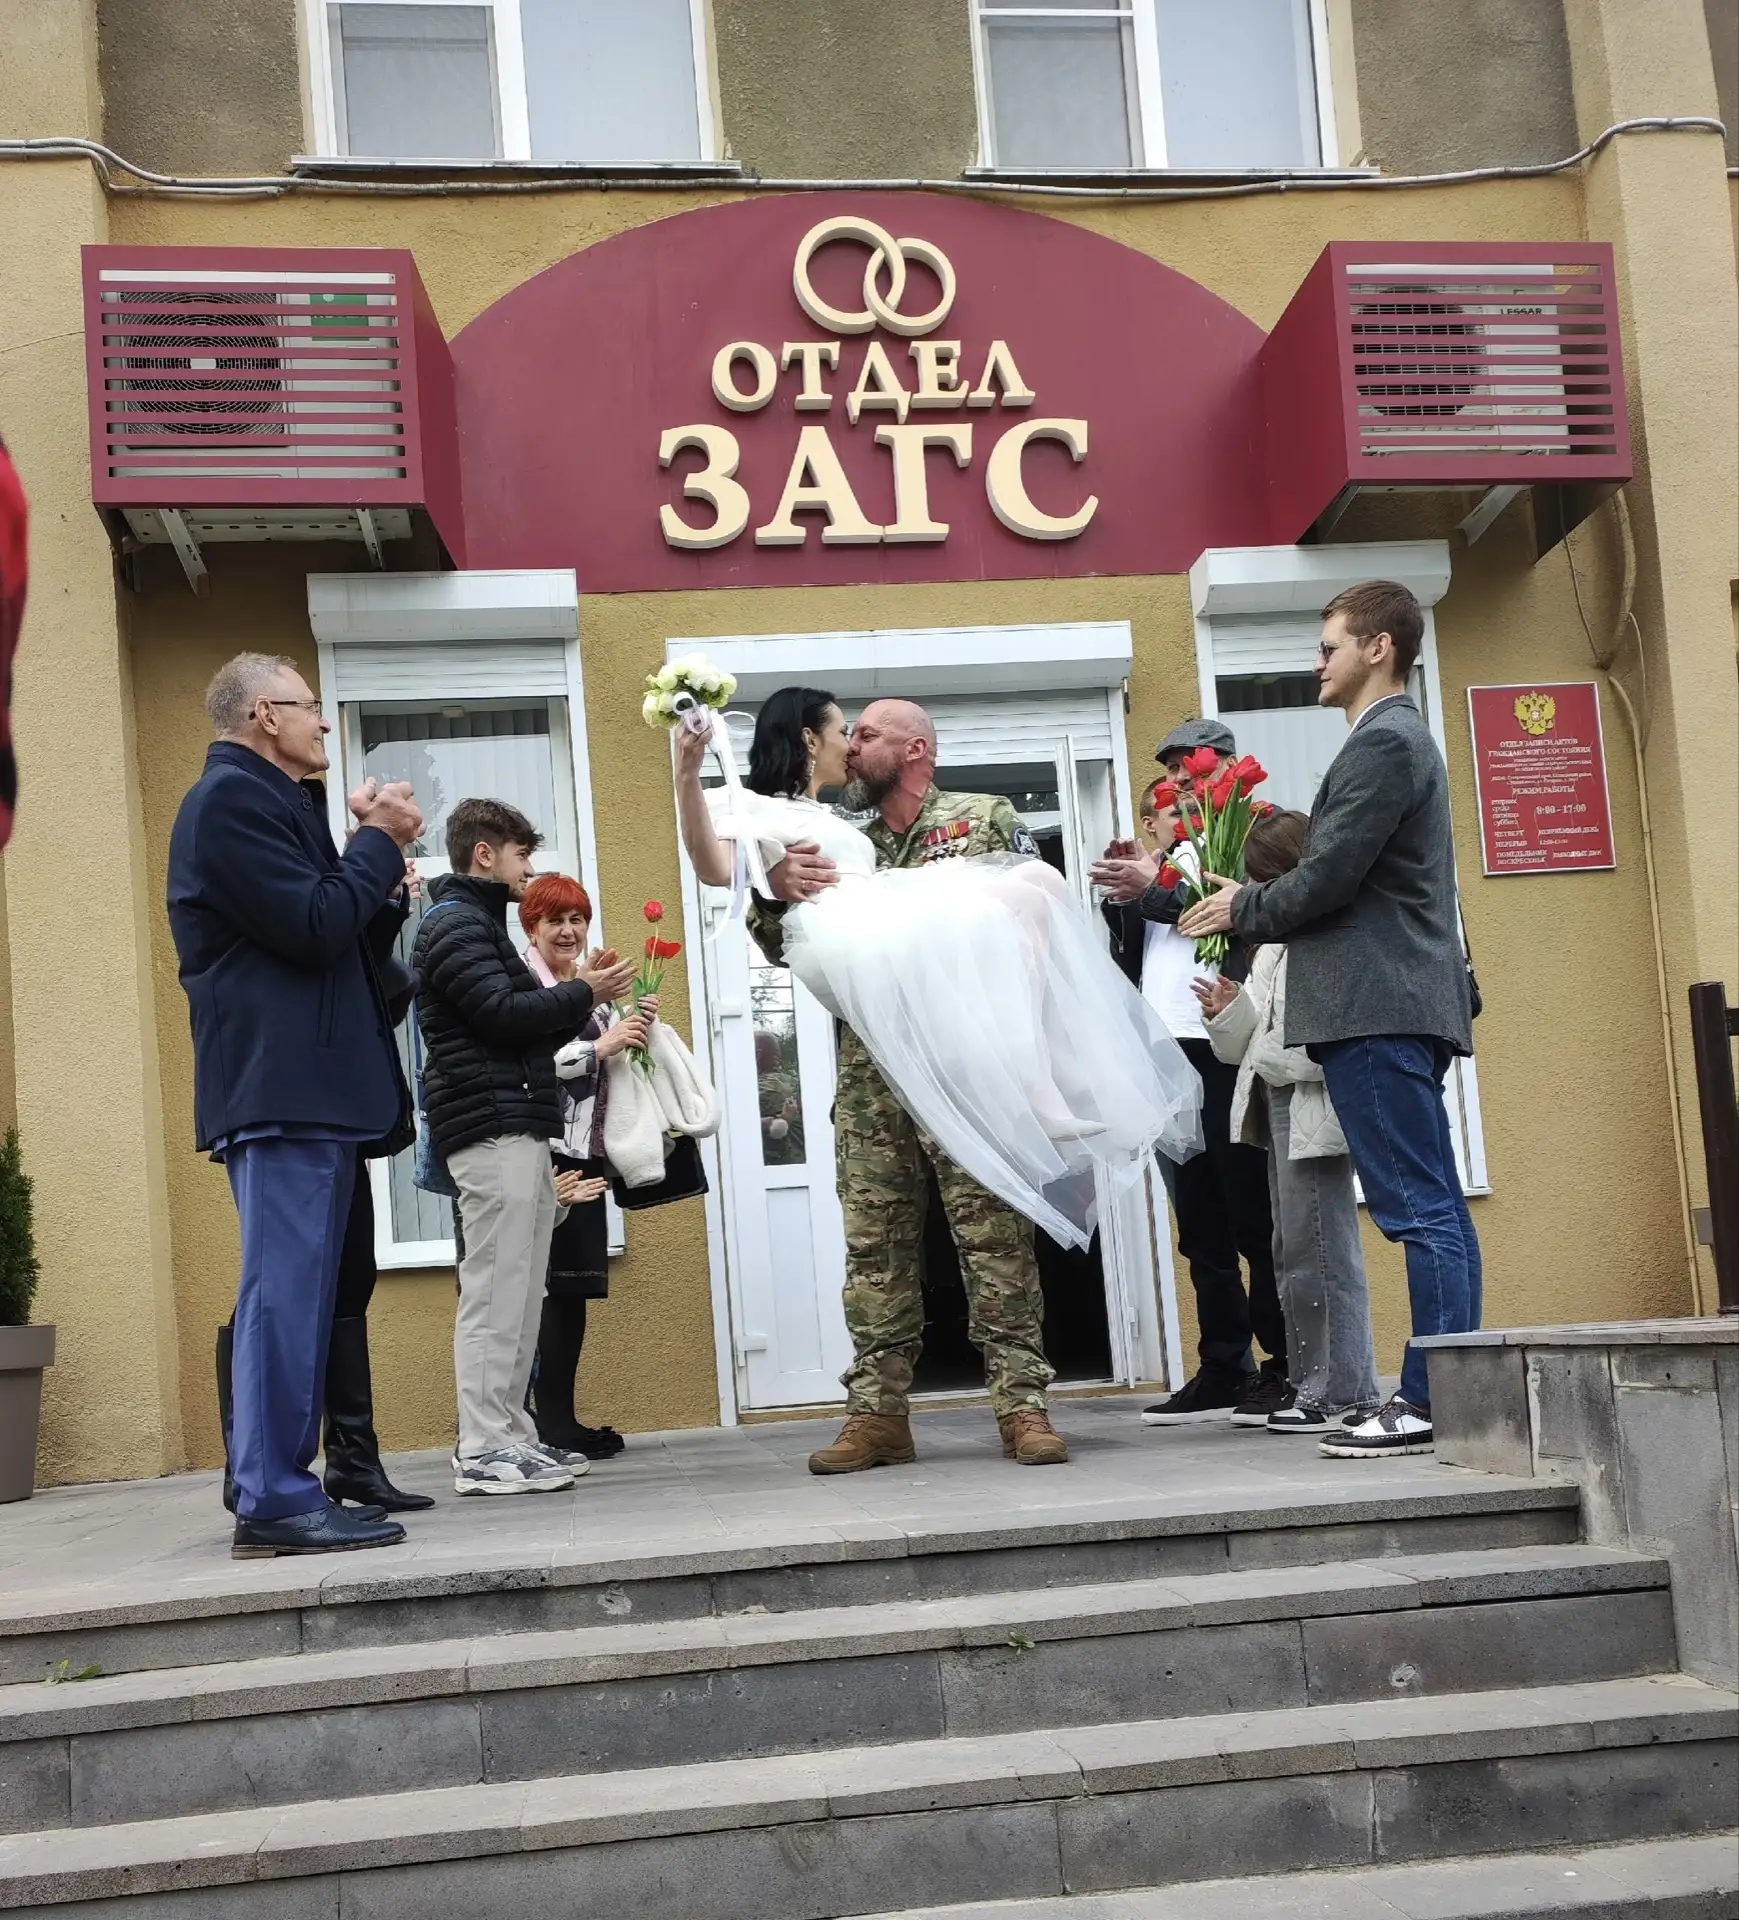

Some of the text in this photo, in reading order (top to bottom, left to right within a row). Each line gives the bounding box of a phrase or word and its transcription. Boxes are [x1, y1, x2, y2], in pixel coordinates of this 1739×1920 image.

[711, 339, 1035, 425] ОТДЕЛ
[658, 418, 1099, 549] ЗАГС
[1543, 785, 1575, 793] РАБОТЫ
